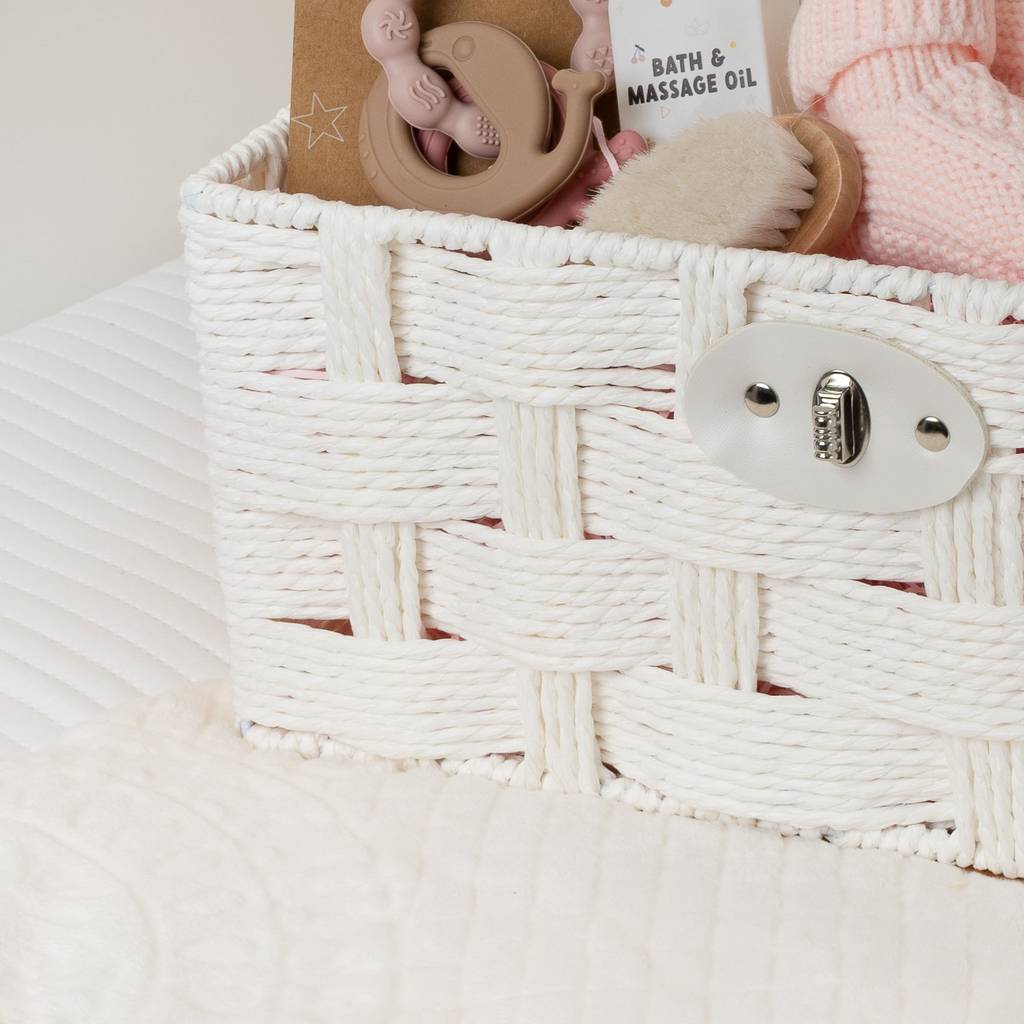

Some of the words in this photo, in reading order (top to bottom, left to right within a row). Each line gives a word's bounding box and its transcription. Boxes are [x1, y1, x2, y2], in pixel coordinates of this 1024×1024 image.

[652, 51, 703, 77] BATH
[711, 48, 725, 67] &
[628, 73, 718, 106] MASSAGE
